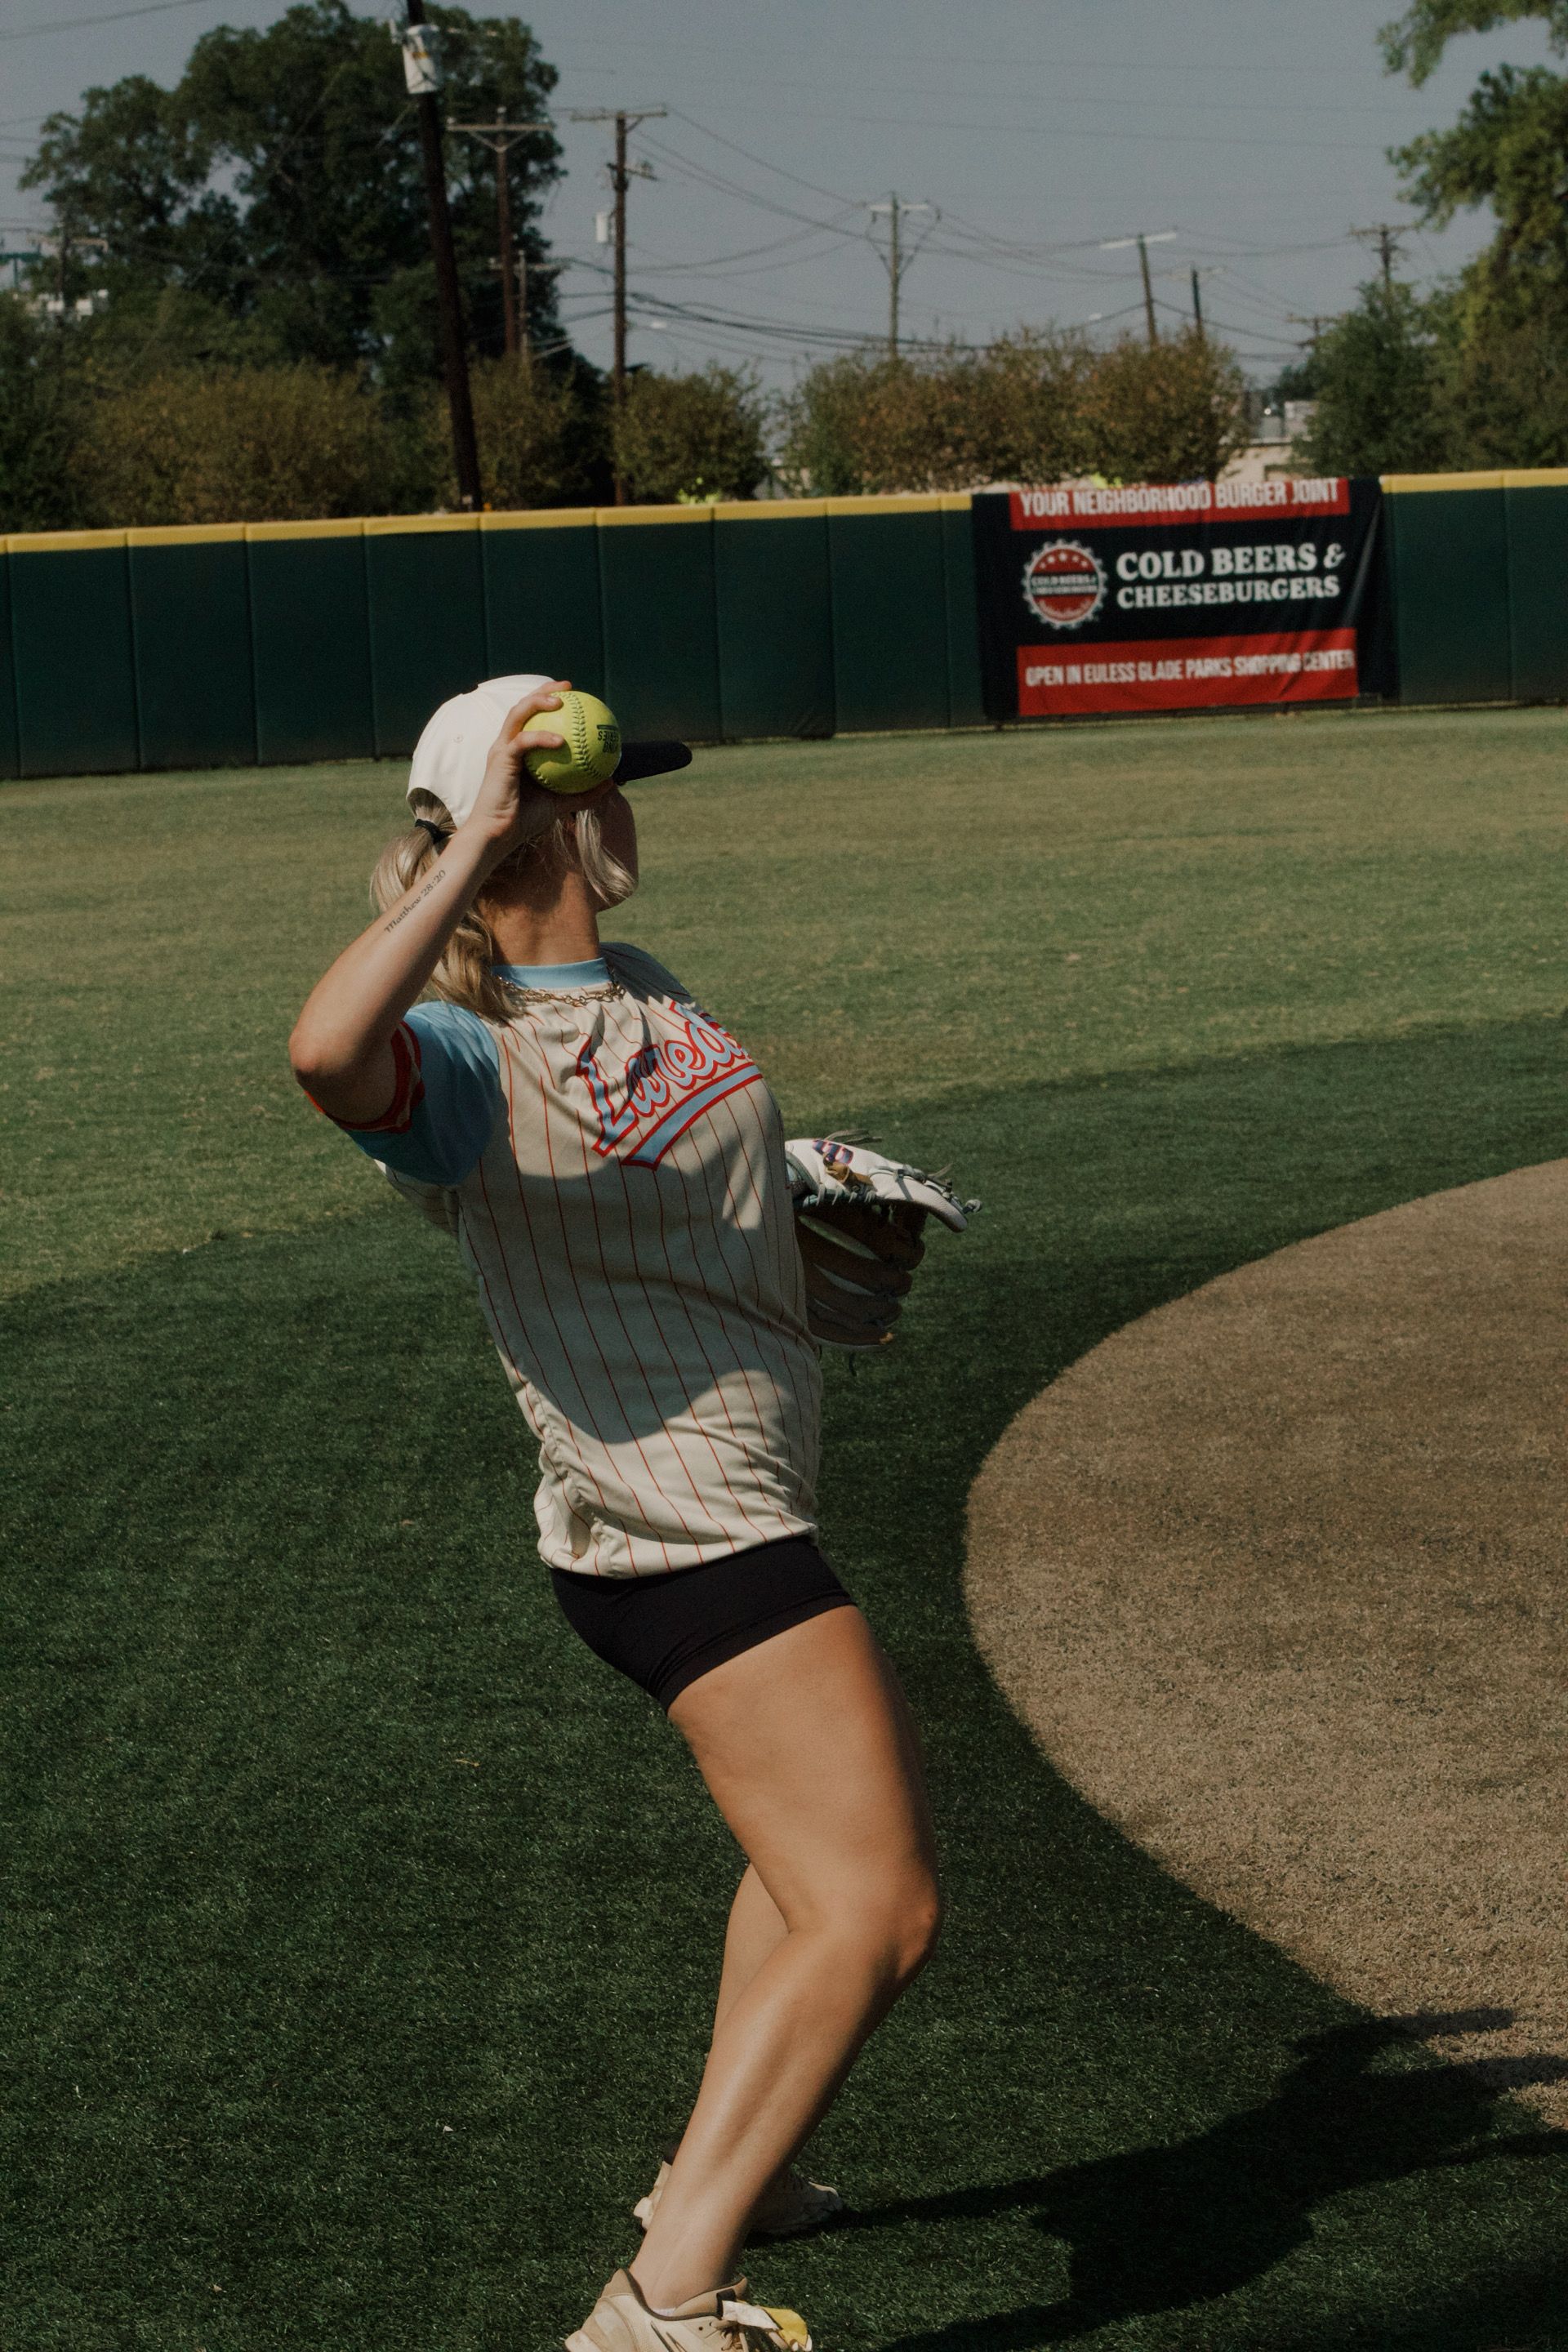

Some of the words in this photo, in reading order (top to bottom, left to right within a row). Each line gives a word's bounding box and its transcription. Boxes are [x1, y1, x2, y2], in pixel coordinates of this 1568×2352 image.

[1021, 491, 1070, 517] YOUR
[1073, 482, 1211, 515] NEIGHBORHOOD
[1214, 480, 1287, 509] BURGER
[1292, 477, 1339, 505] JOINT
[1116, 549, 1205, 581] COLD
[1211, 542, 1318, 576] BEERS
[1323, 543, 1346, 569] &
[1116, 575, 1341, 609] CHEESEBURGERS
[1026, 666, 1063, 687] OPEN
[1066, 664, 1082, 684] IN
[1084, 662, 1136, 684] EULESS
[1138, 659, 1183, 681] GLADE
[1186, 657, 1232, 679] PARKS
[1233, 653, 1302, 677] SHOPPING
[1303, 648, 1356, 671] CENTER
[384, 896, 421, 933] Matthew
[421, 869, 447, 897] 28:20
